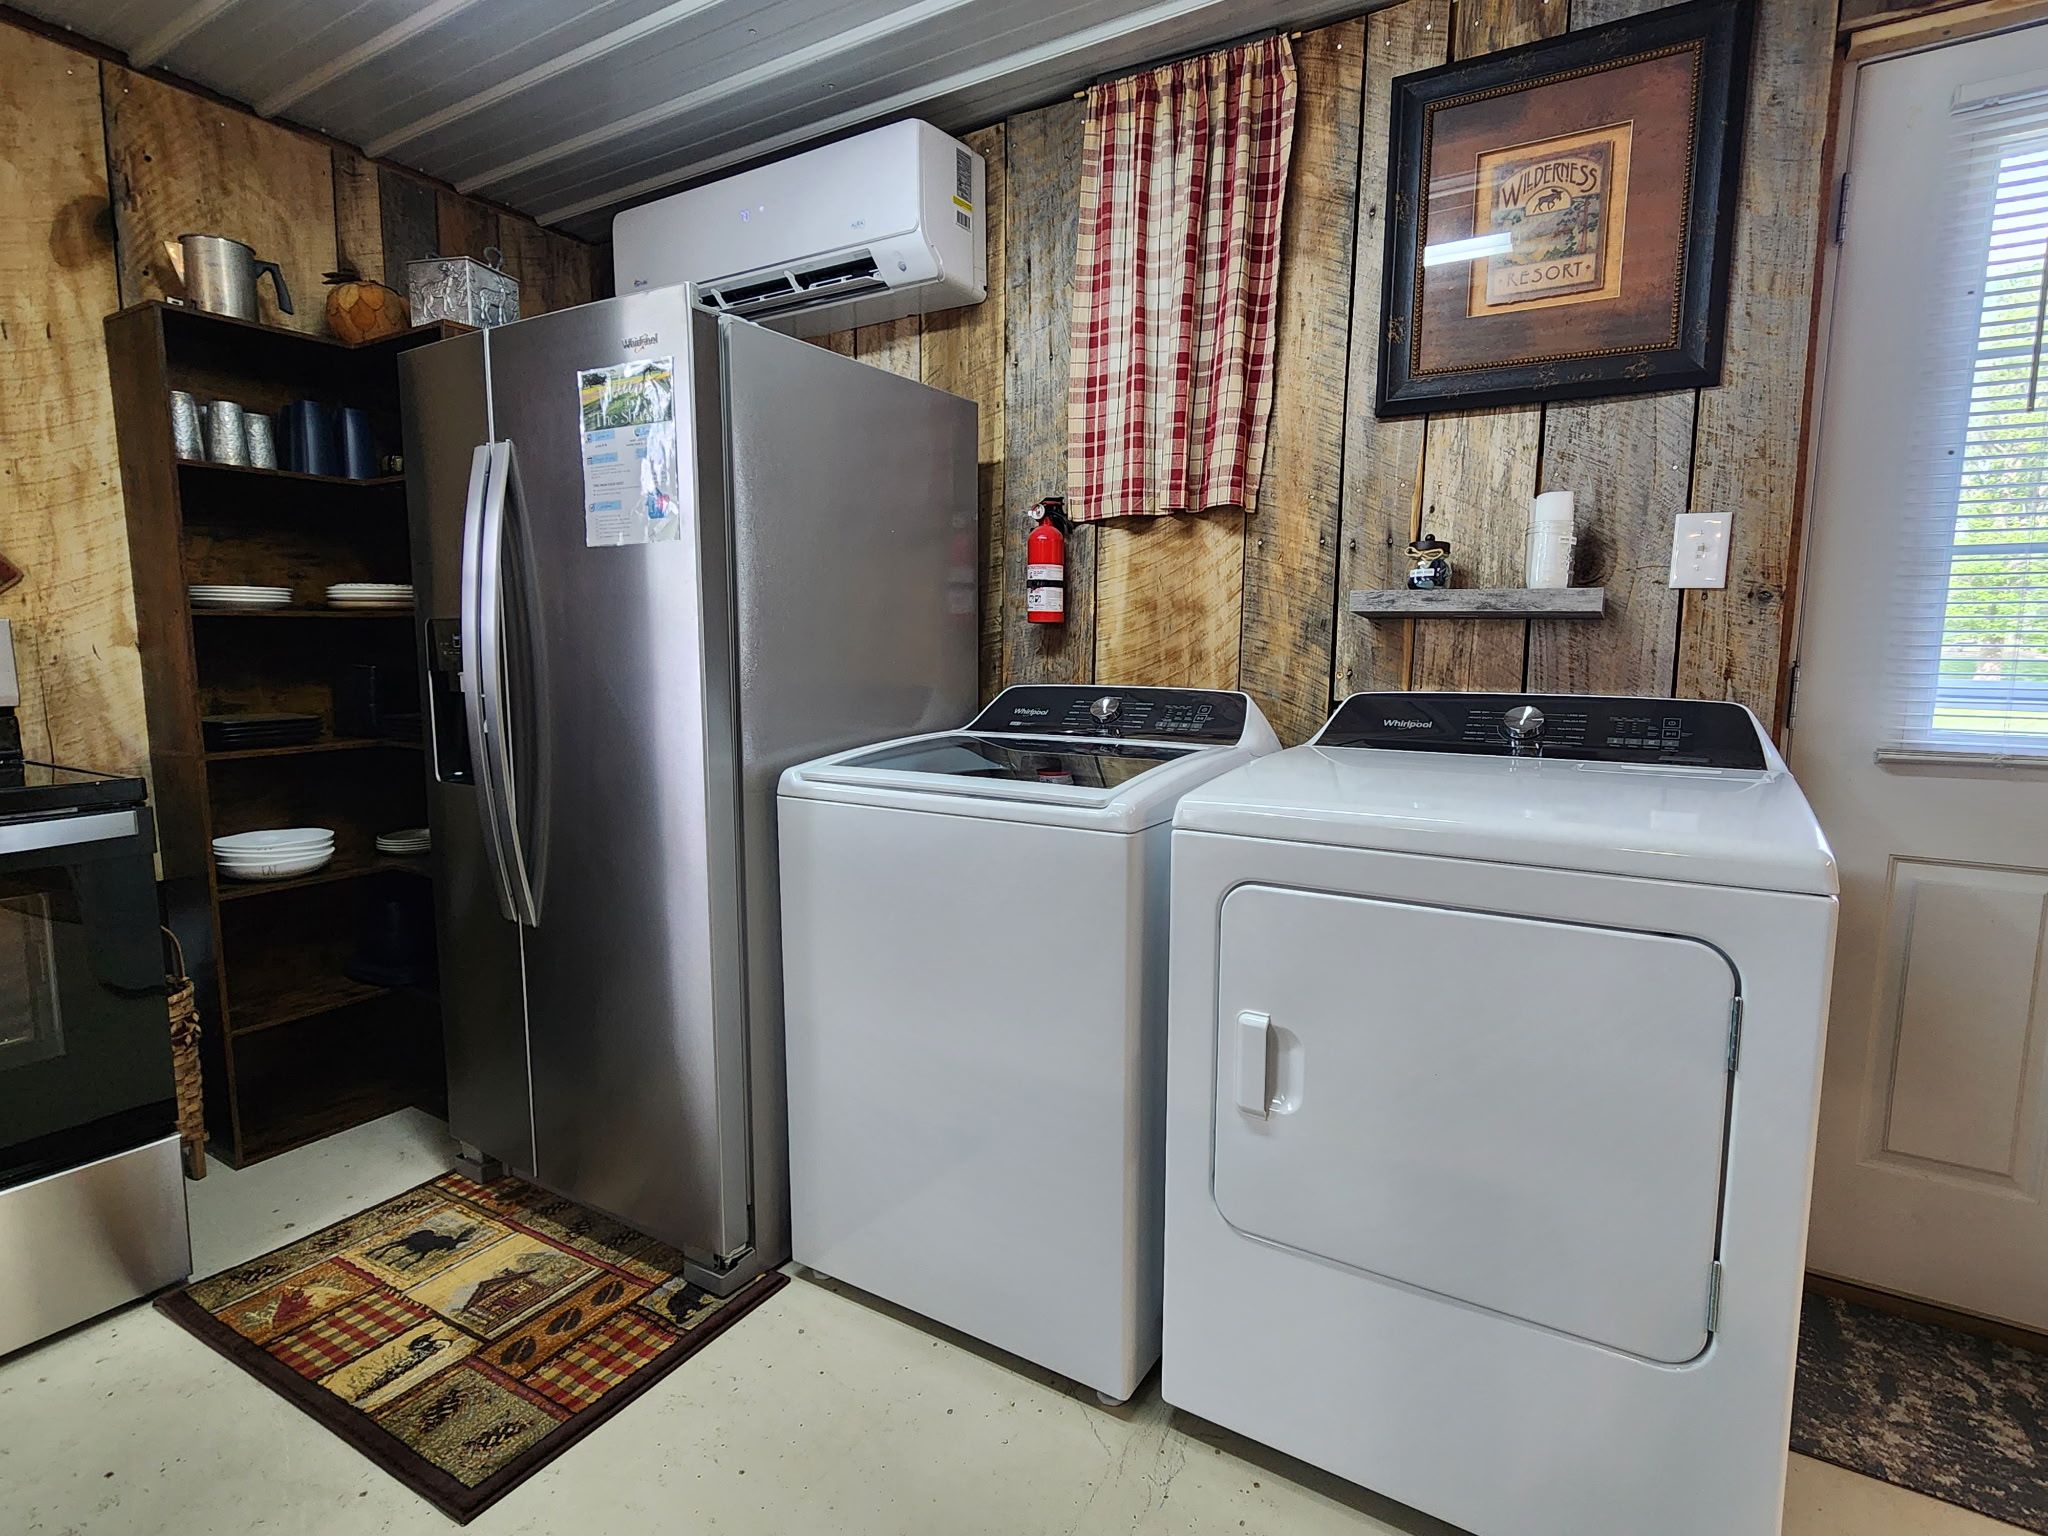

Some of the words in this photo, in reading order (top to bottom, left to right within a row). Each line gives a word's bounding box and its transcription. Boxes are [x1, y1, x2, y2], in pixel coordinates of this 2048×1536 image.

[1502, 163, 1598, 209] WILDERNESS
[1507, 262, 1583, 287] RESORT
[1013, 707, 1049, 717] Whirlpool
[1383, 719, 1433, 729] Whirlpool
